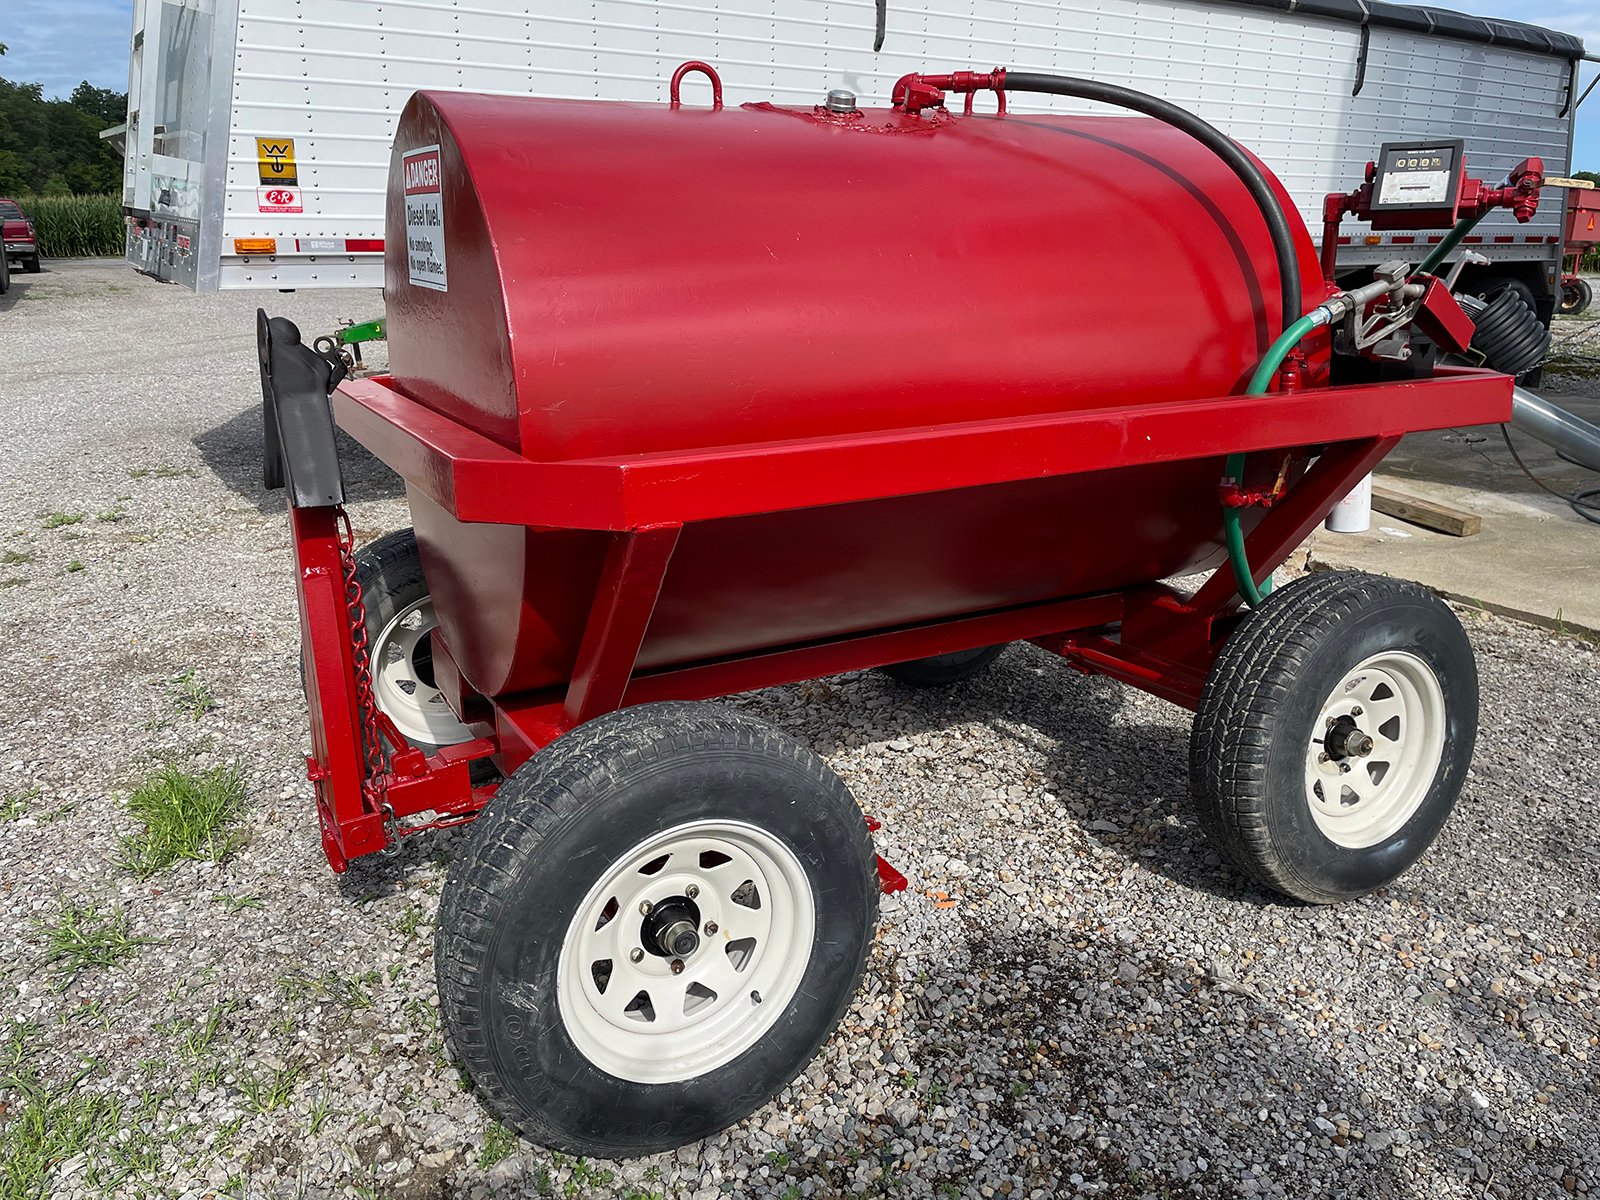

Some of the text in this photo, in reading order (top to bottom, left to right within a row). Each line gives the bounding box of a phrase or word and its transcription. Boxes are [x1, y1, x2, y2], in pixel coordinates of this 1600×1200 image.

[410, 159, 438, 188] DANGER
[407, 203, 441, 227] Diesel fuel.
[409, 236, 415, 251] No
[410, 255, 416, 270] No
[416, 259, 426, 275] open
